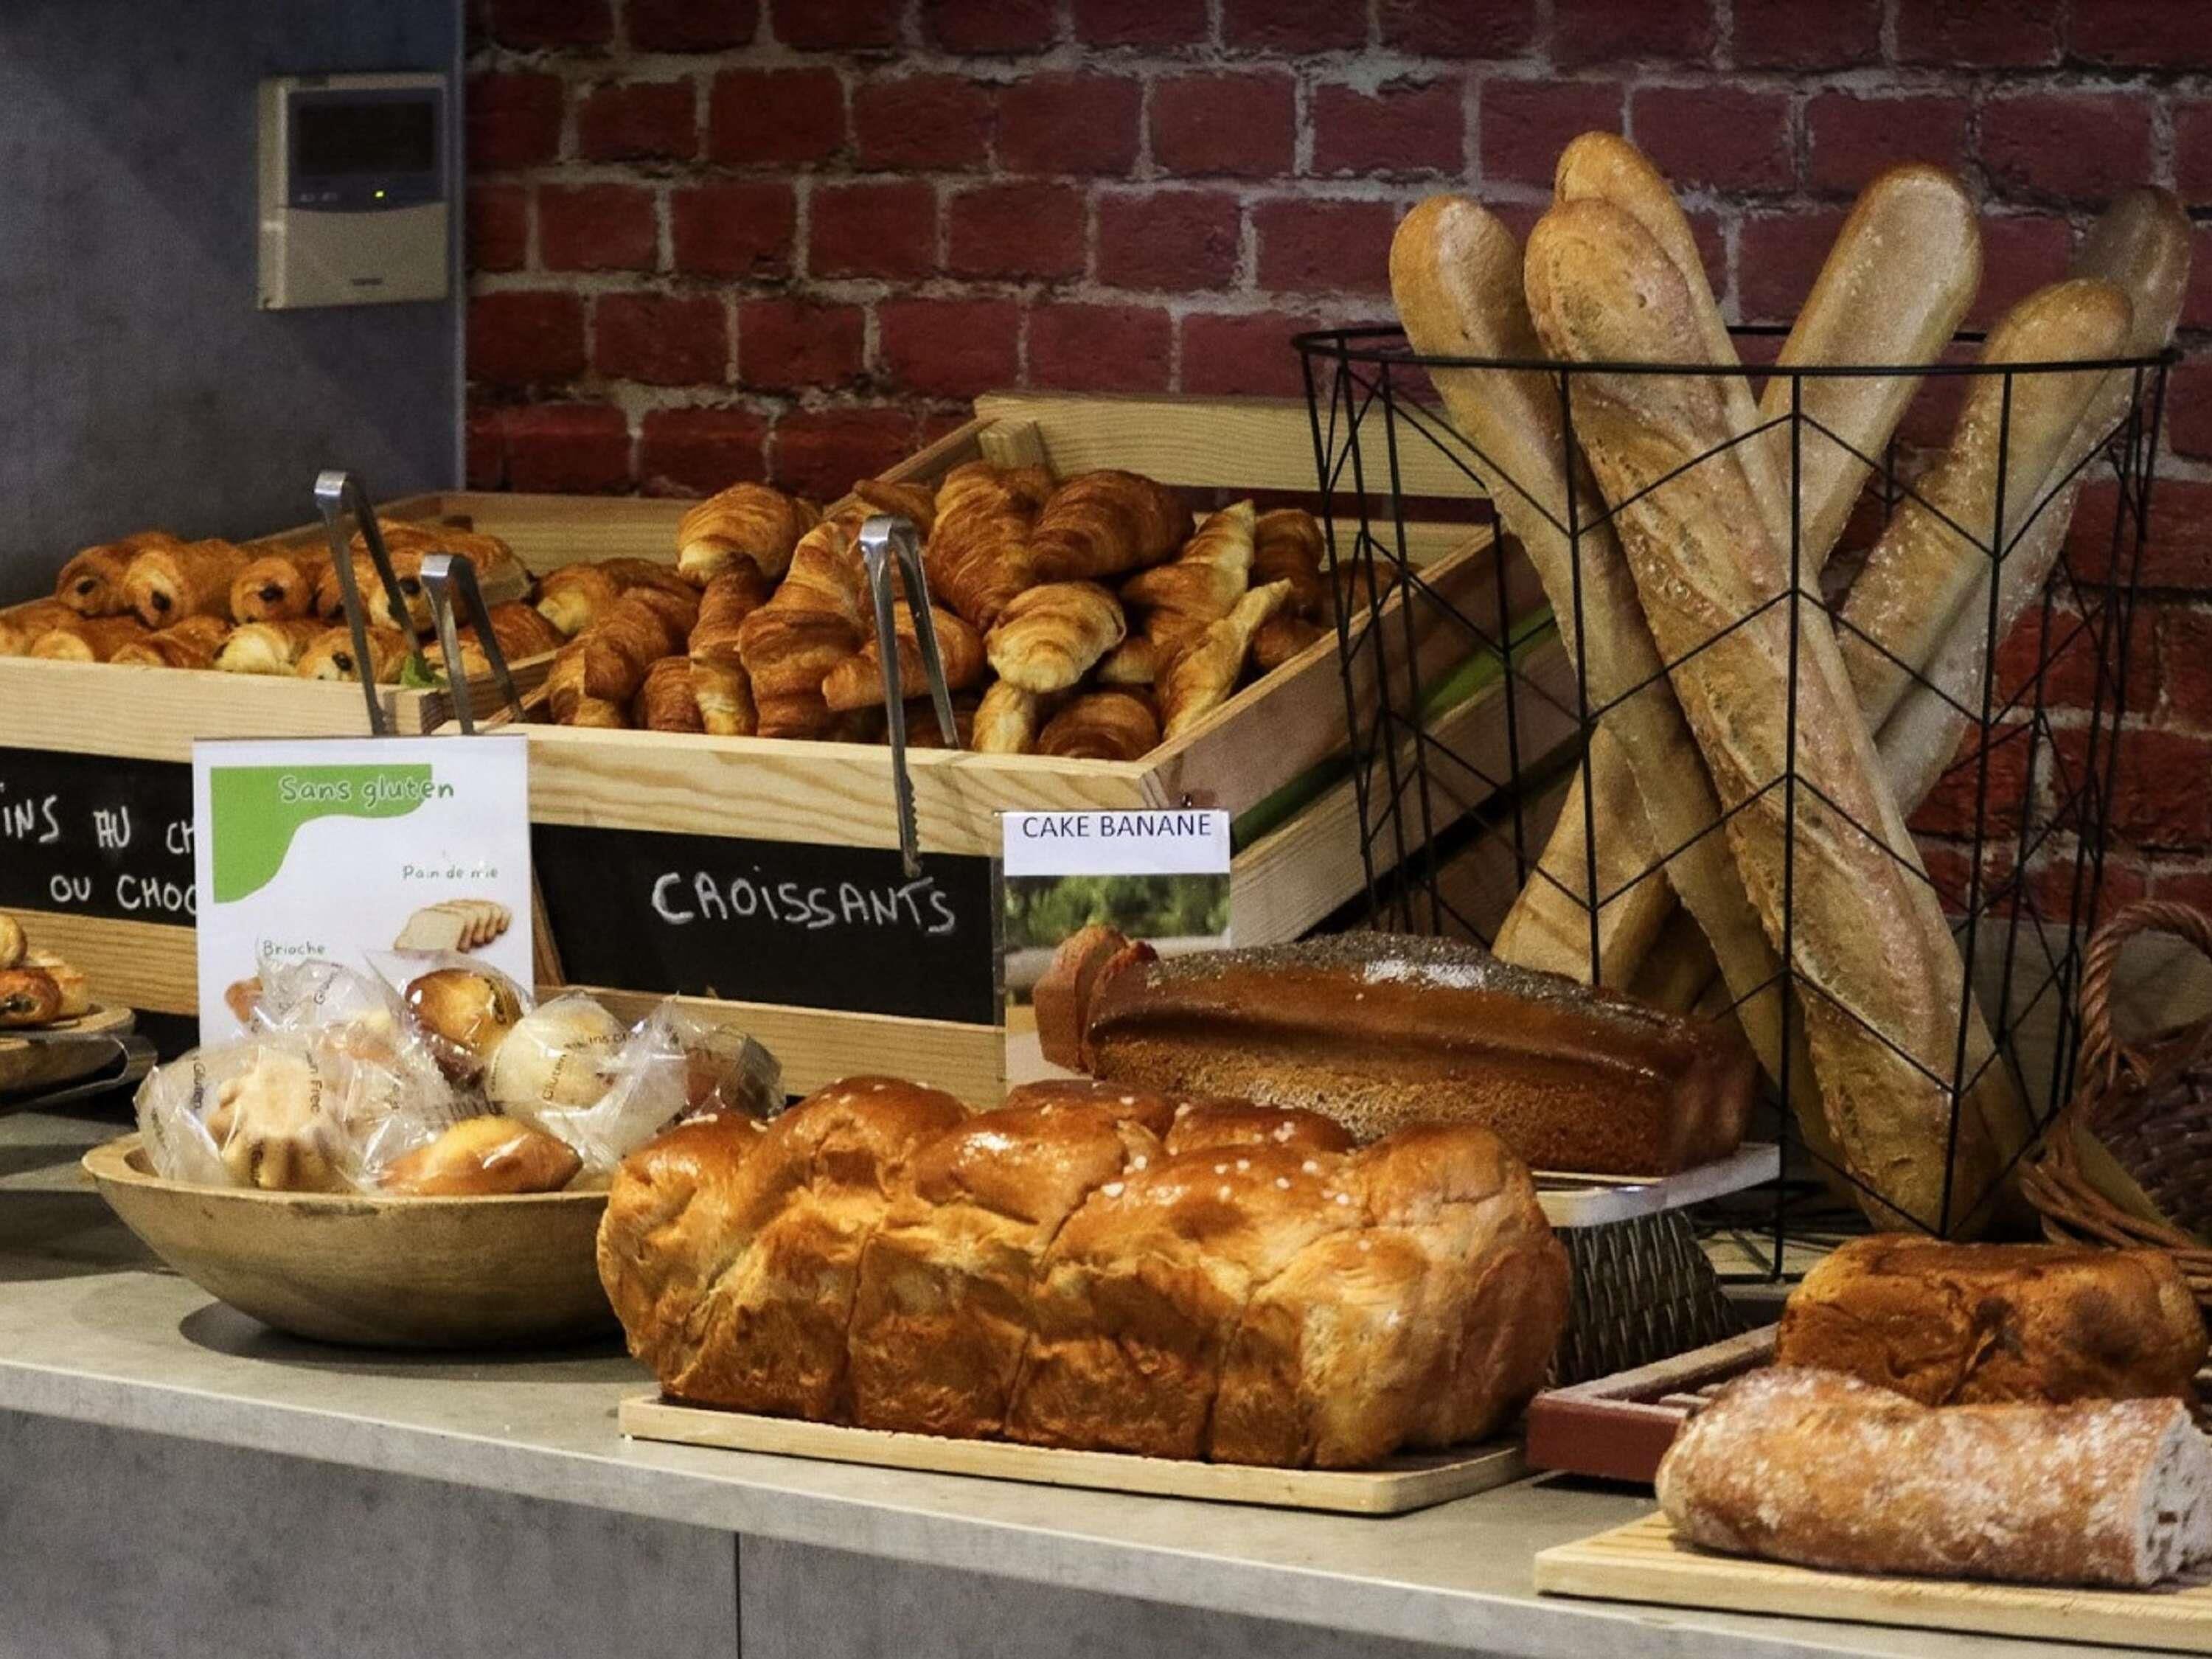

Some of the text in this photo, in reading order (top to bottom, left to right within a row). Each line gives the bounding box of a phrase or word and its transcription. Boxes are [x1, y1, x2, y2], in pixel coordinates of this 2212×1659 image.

[281, 776, 454, 807] Sans gluten
[1023, 813, 1211, 838] CAKE BANANE
[447, 865, 465, 878] de
[49, 874, 91, 902] OU
[263, 939, 326, 956] Brioche
